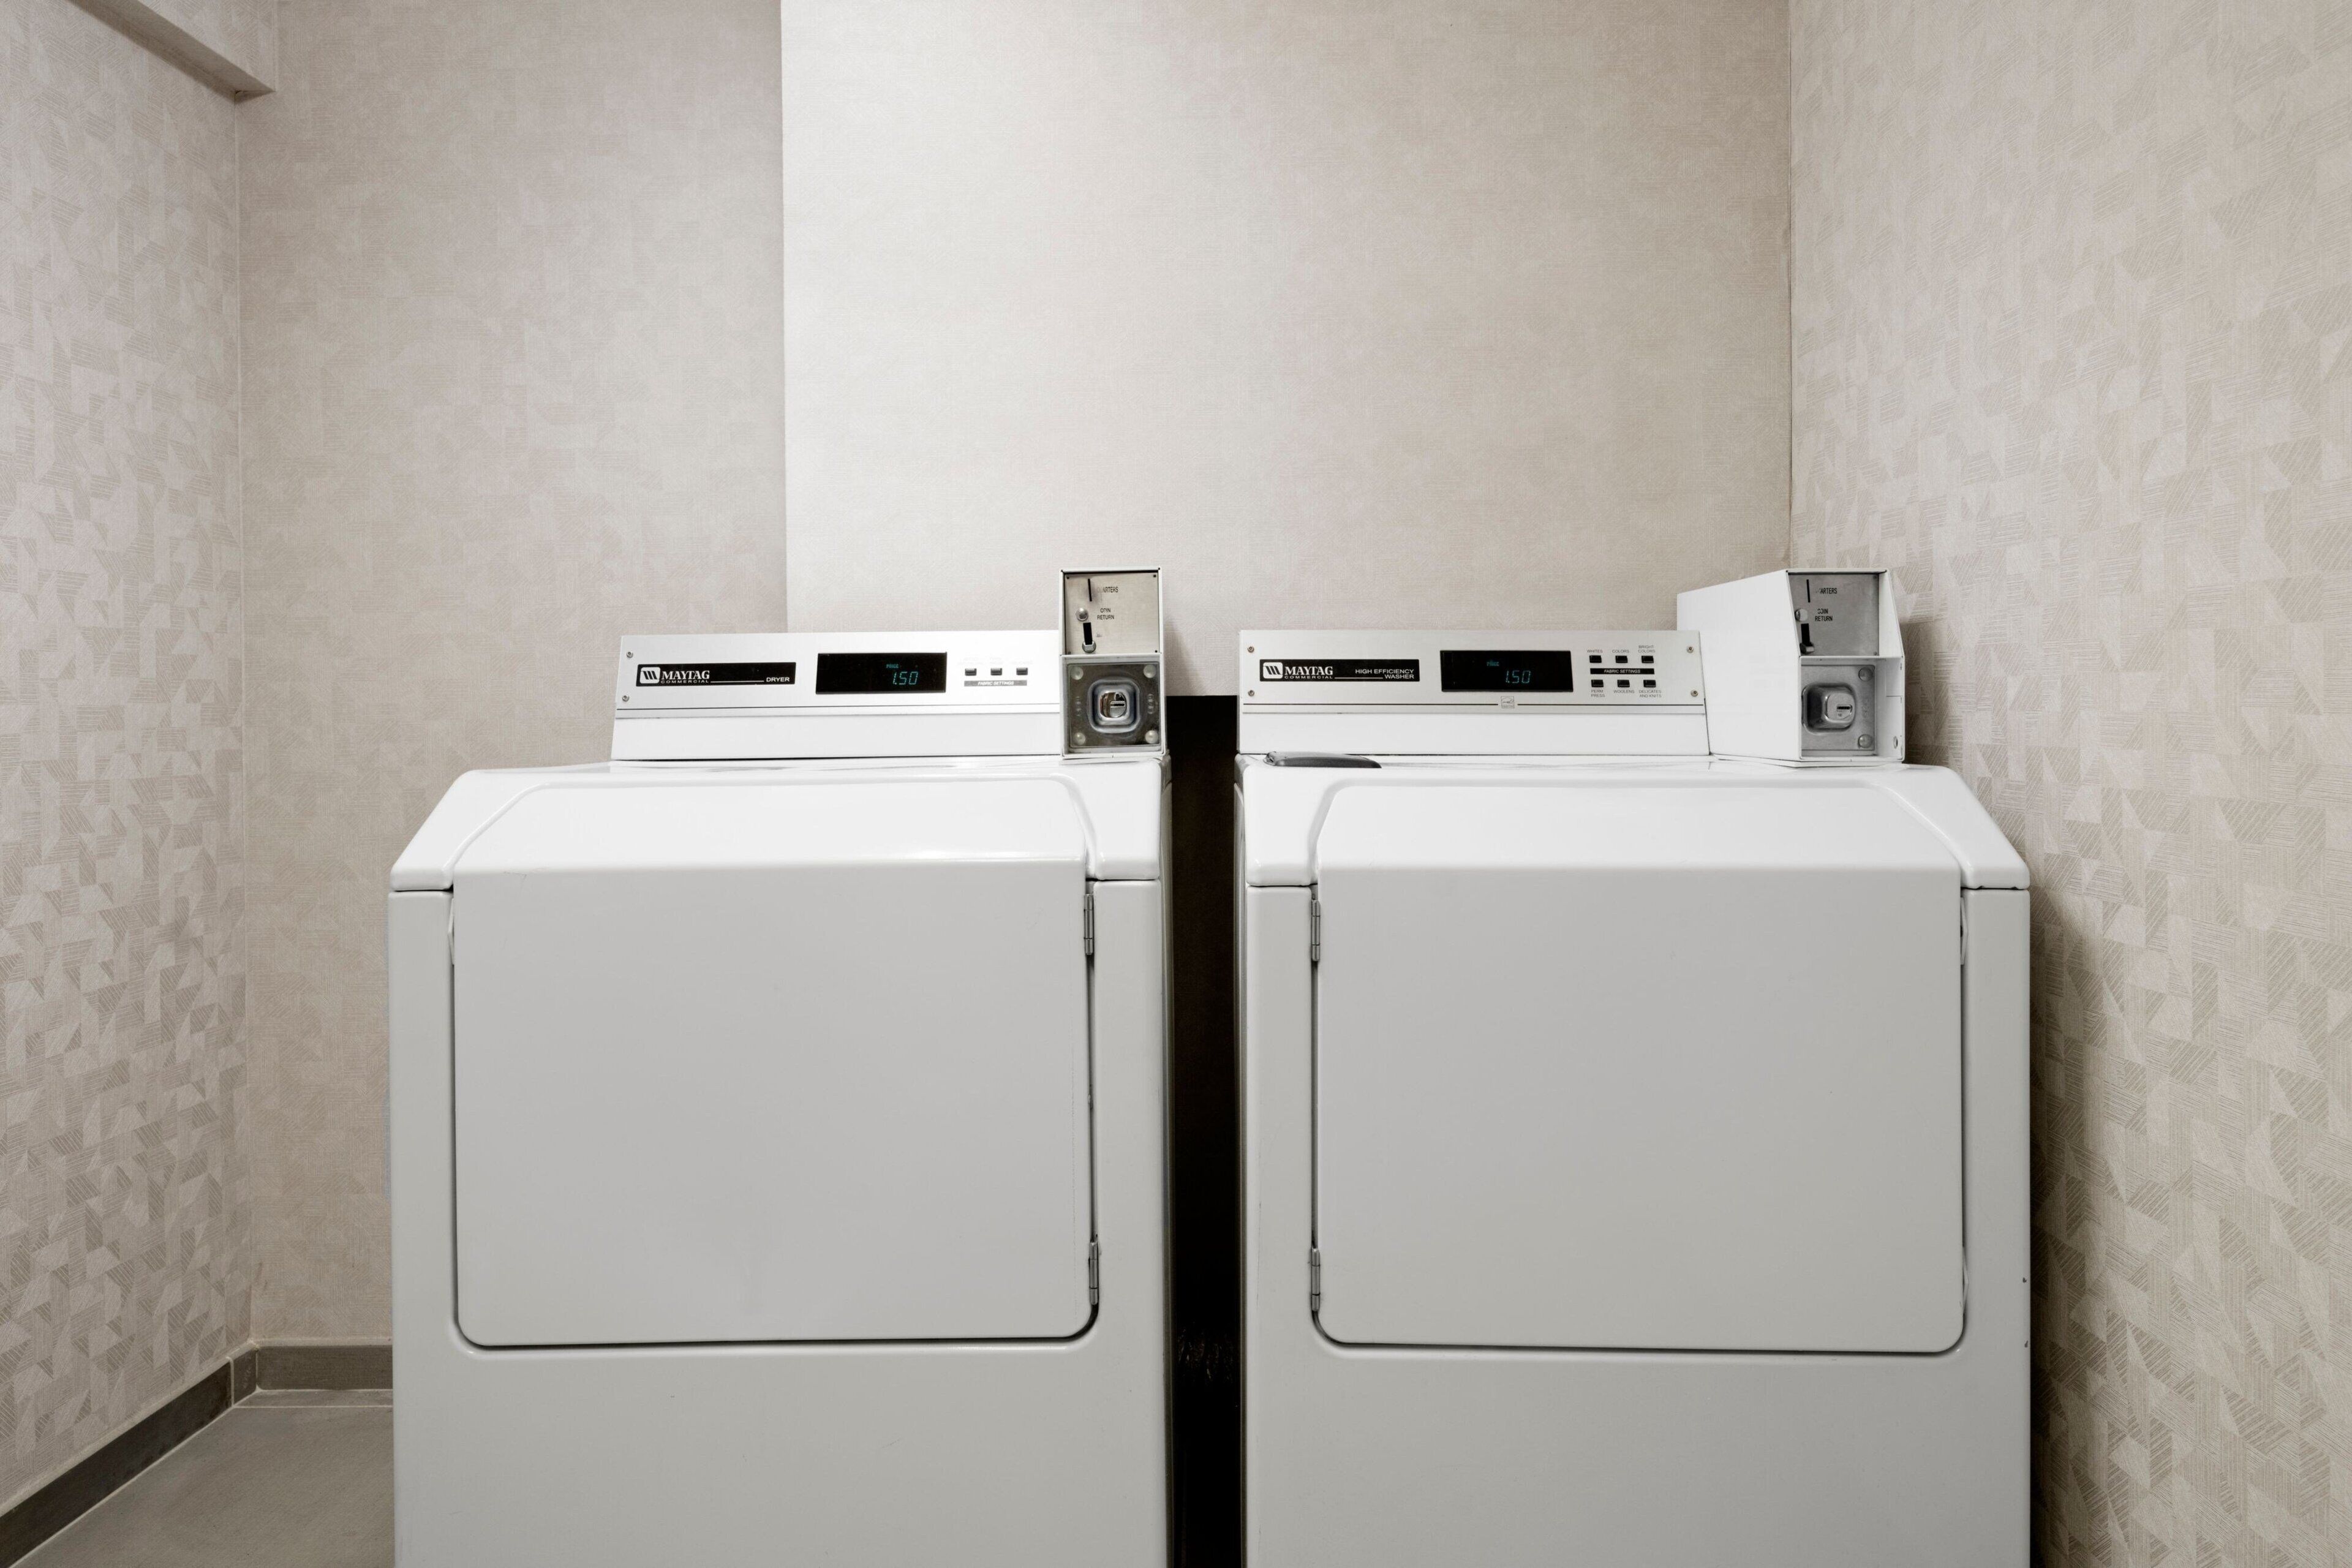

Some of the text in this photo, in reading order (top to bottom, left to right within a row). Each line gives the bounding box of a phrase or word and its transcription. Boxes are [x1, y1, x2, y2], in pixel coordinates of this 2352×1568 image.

[661, 670, 710, 680] MAYTAG
[1284, 666, 1333, 676] MAYTAG
[1506, 670, 1531, 684] 1.50
[892, 671, 918, 685] 1.50
